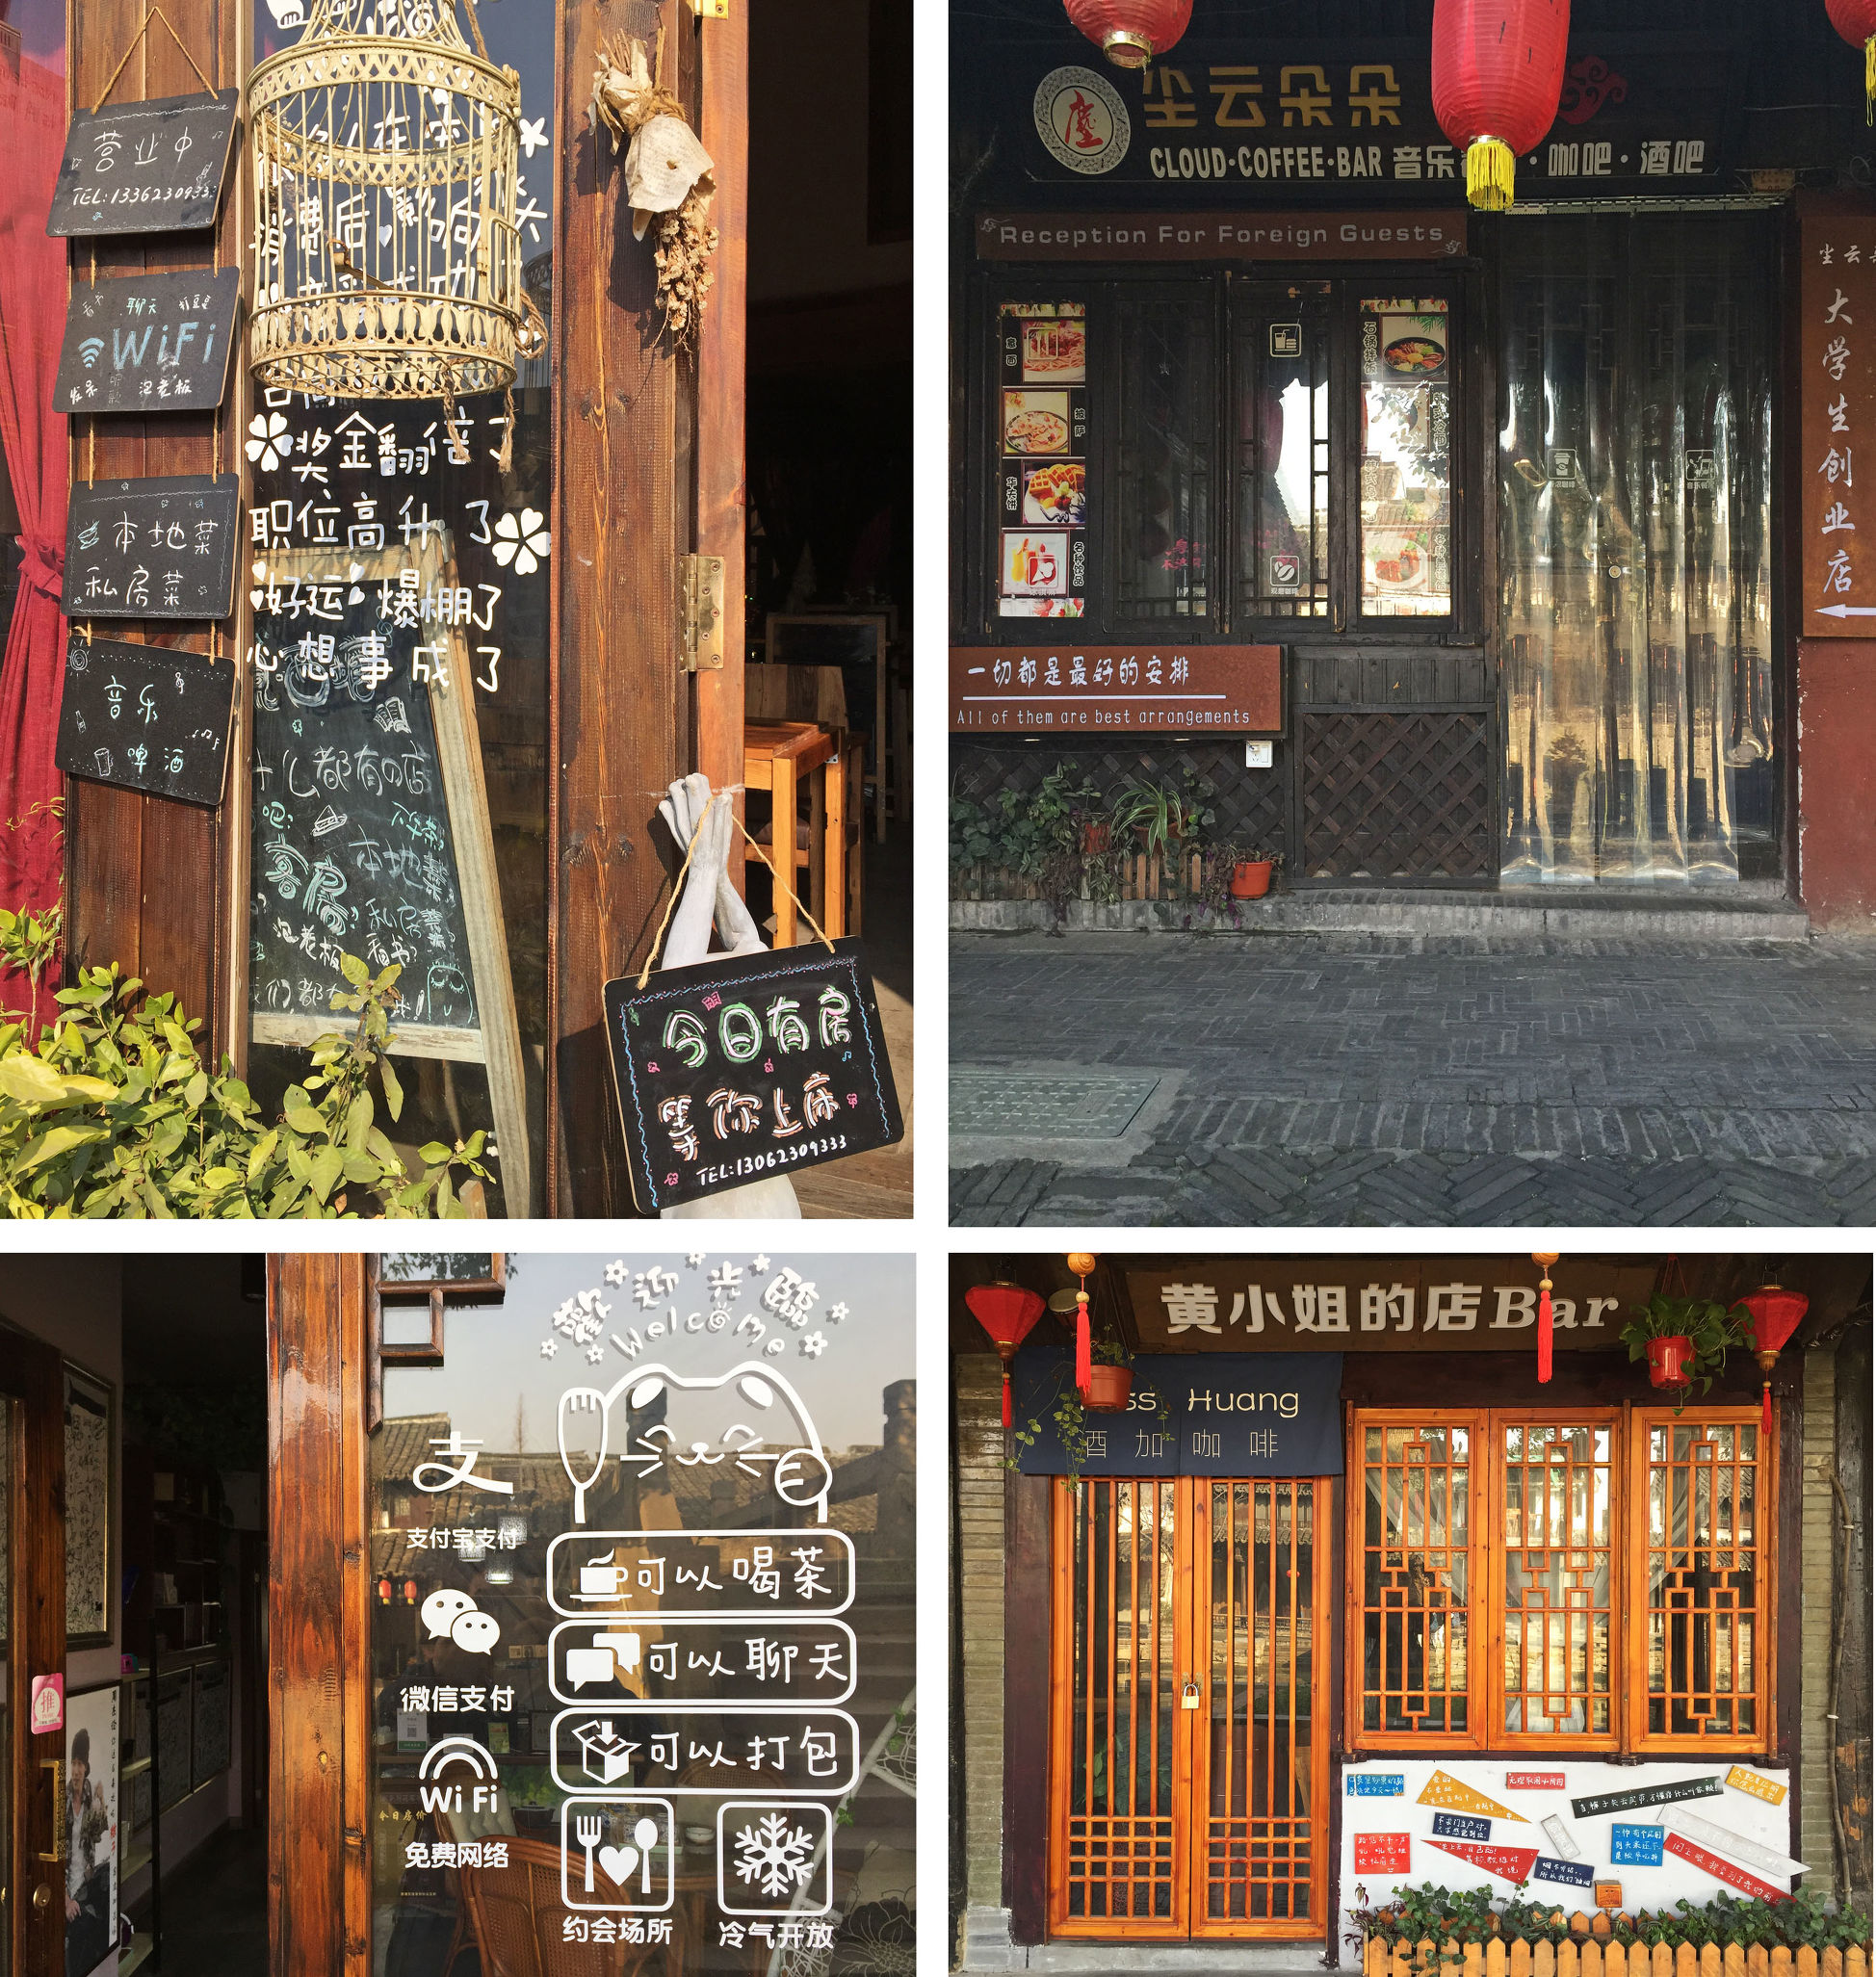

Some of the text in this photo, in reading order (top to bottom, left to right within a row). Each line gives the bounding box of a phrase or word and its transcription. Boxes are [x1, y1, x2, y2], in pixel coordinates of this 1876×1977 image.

[1143, 65, 1402, 128] 尘云朵朵
[93, 126, 194, 172] 营业中
[1000, 223, 1443, 247] Reception For Foreign Guests
[126, 297, 157, 316] 聊天
[113, 321, 217, 371] WiFi
[1364, 322, 1377, 376] 石锅拌饭
[1818, 289, 1856, 594] 大学生创业店
[113, 510, 219, 555] 本地菜
[248, 488, 491, 551] 职位高升了
[85, 564, 184, 607] 私房菜
[967, 655, 1189, 688] 一切都是最好的安排
[103, 675, 158, 724] 音乐
[957, 709, 1251, 727] All of them are best arrangements
[127, 743, 184, 773] 啤酒
[663, 984, 851, 1069] 今日有房
[1160, 1283, 1620, 1334] 黄小姐的店 Bar
[1187, 1388, 1300, 1418] Huang
[406, 1527, 519, 1549] 支付宝支付
[638, 1546, 832, 1600] 可以喝茶
[649, 1637, 848, 1684] 可以聊天
[41, 1690, 55, 1713] 推
[399, 1684, 515, 1713] 微信支付
[650, 1725, 838, 1778] 可以打包
[378, 1809, 428, 1822] 今日房价
[404, 1842, 509, 1869] 免费网络
[561, 1915, 674, 1945] 约会场所
[718, 1920, 835, 1950] 冷气开放
